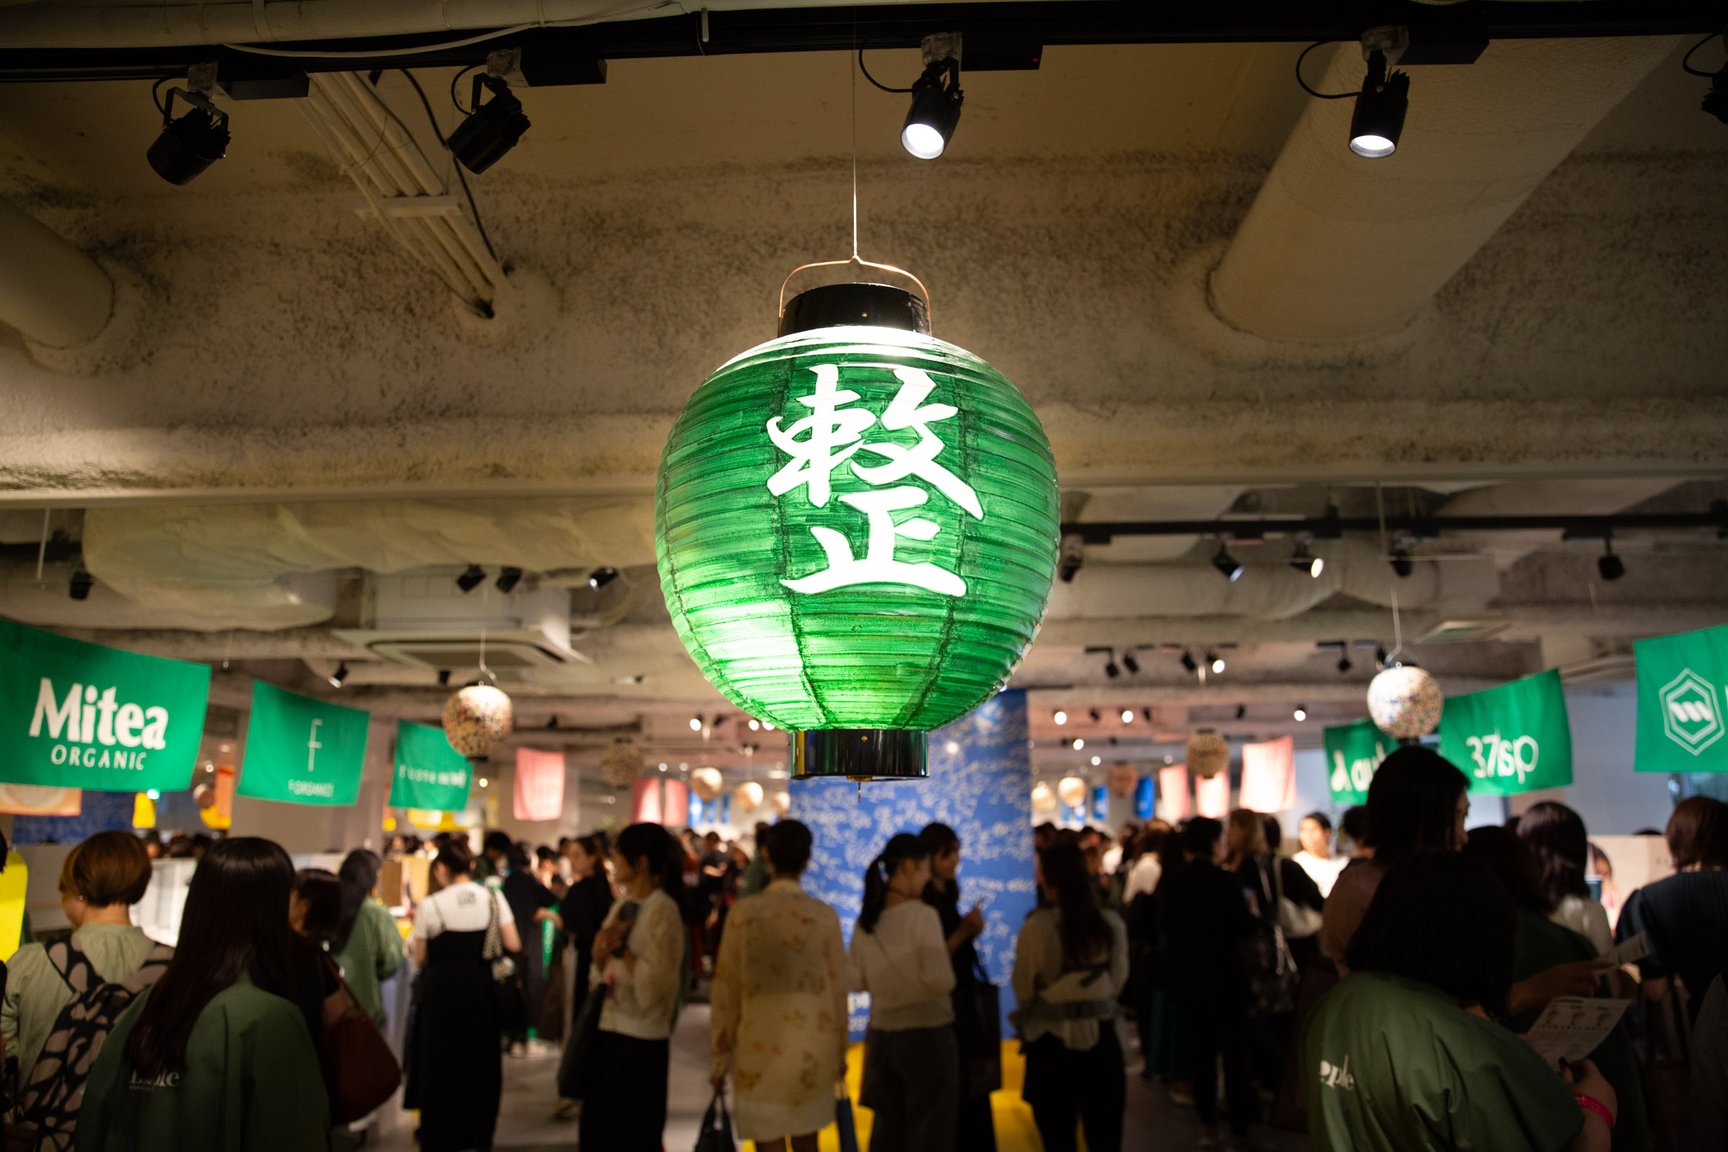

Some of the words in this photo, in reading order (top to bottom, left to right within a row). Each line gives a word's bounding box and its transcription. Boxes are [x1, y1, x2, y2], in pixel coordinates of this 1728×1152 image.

[766, 363, 984, 597] 整
[29, 677, 168, 750] Mitea
[51, 744, 147, 771] ORGANIC
